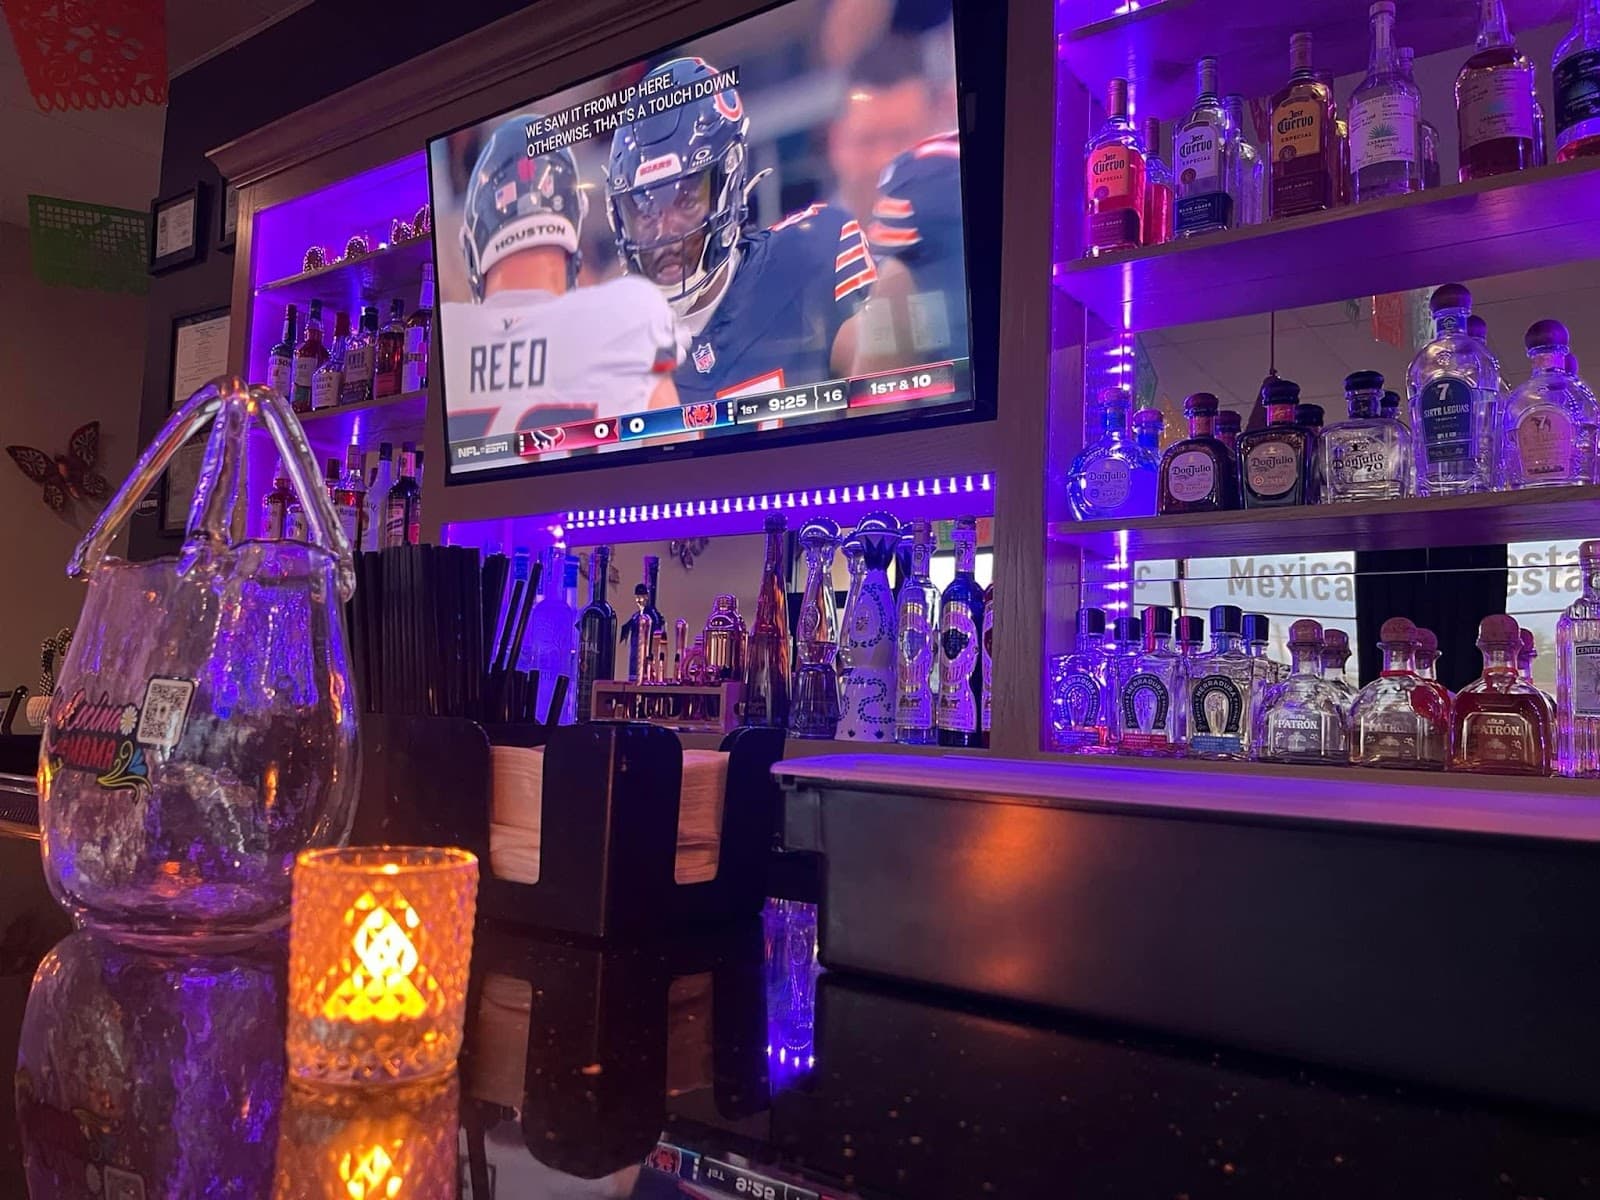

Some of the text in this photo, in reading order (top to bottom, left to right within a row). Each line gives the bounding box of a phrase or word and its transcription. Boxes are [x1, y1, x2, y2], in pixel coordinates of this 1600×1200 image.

[525, 73, 673, 139] WE SAW IT FROM UP HERE.
[526, 70, 740, 158] OTHERWISE, THAT'S A TOUCH DOWN.
[495, 224, 566, 252] HOUSTON
[470, 338, 547, 393] REED
[870, 374, 931, 395] 1ST & 10
[1437, 383, 1449, 401] 7
[740, 394, 807, 416] 1ST 9:25
[823, 389, 843, 403] 16
[594, 423, 609, 439] 0
[629, 417, 645, 433] 0
